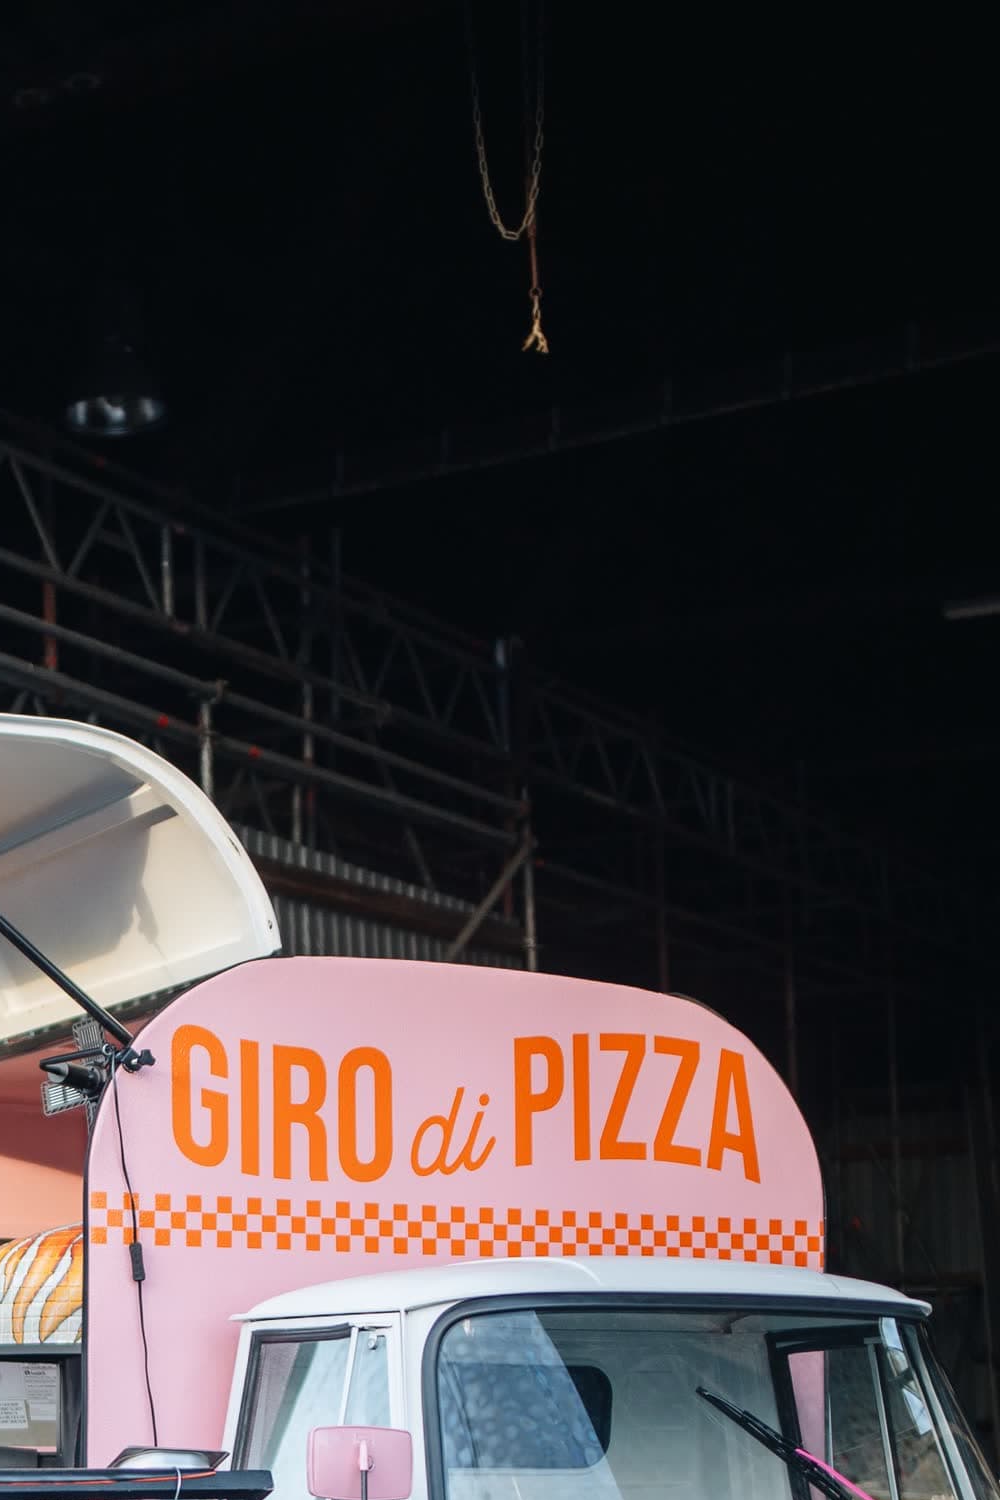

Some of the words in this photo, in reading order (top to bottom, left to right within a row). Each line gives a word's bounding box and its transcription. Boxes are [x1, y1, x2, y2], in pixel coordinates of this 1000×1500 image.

[171, 1024, 393, 1182] GIRO
[410, 1087, 496, 1177] di
[513, 1032, 761, 1185] PIZZA
